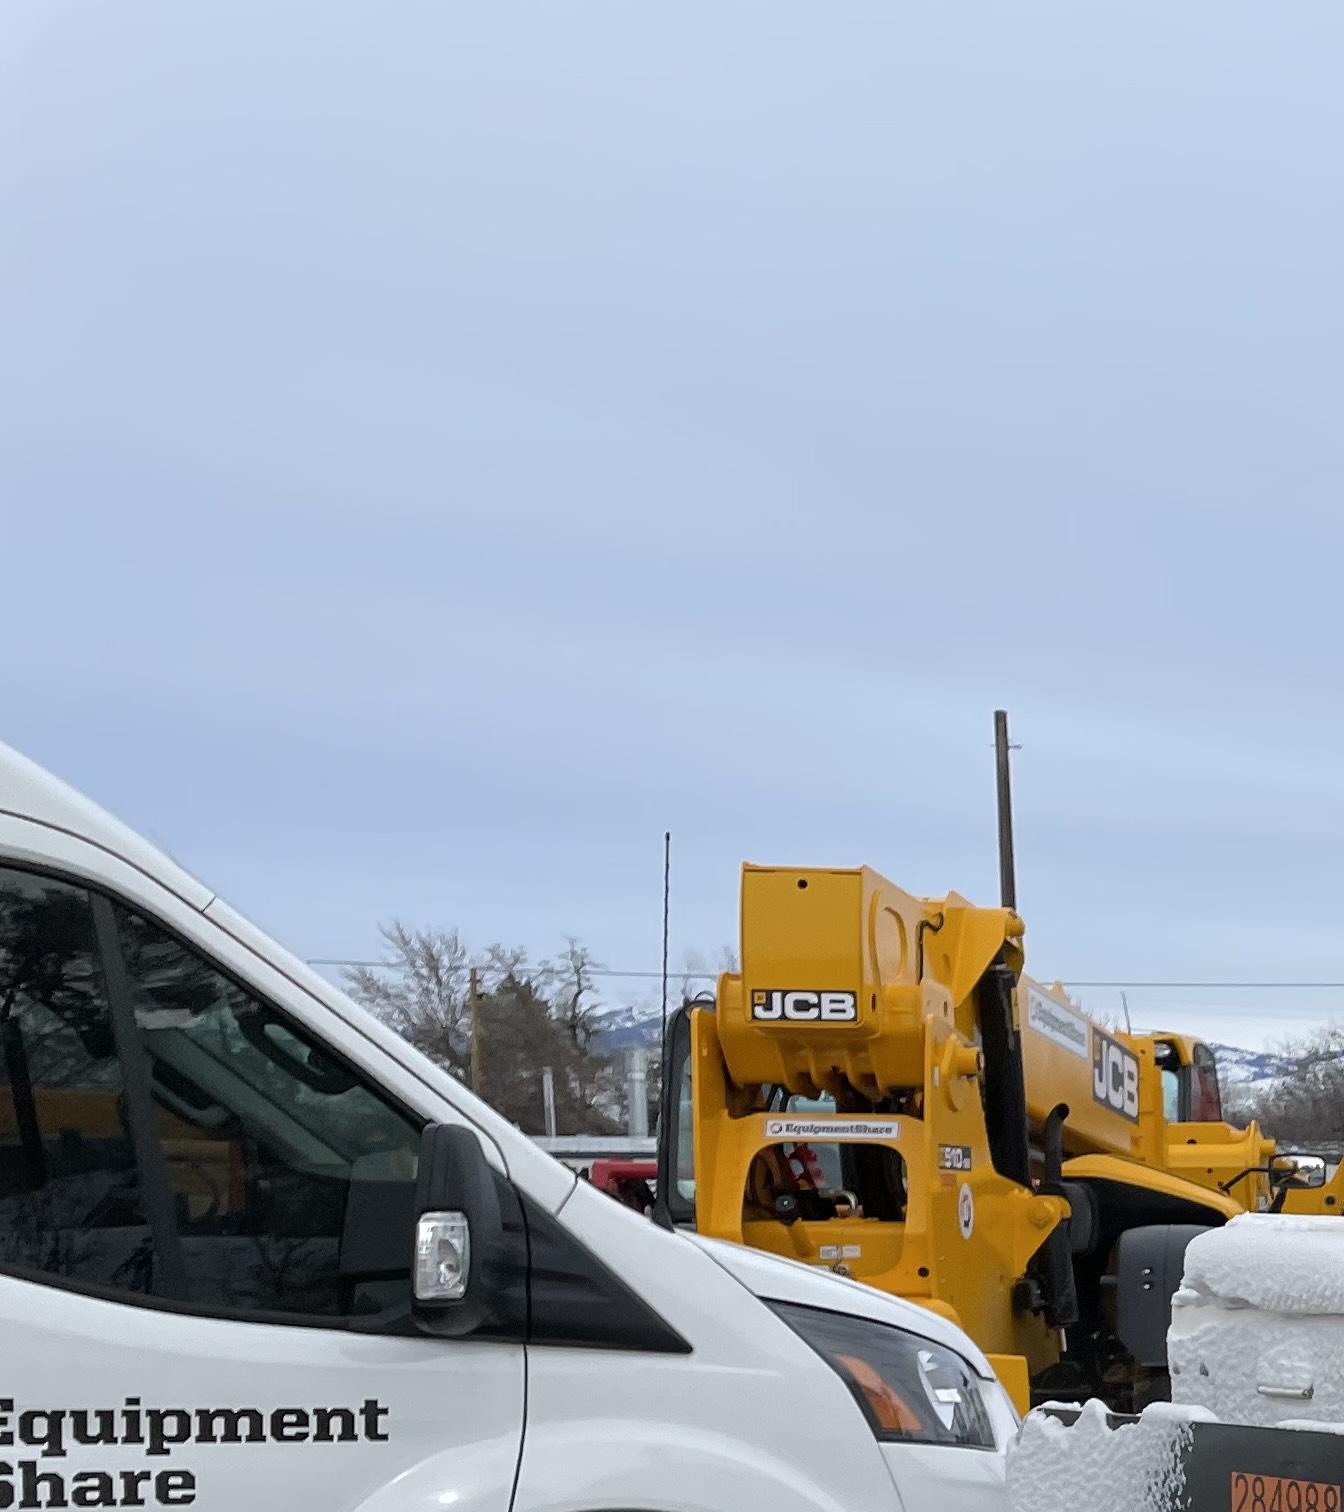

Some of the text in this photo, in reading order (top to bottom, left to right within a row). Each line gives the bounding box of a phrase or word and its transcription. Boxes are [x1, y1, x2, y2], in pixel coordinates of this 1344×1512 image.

[753, 991, 856, 1021] JCB
[1093, 1038, 1140, 1119] JCB
[0, 1397, 389, 1457] quipment
[0, 1460, 196, 1509] hare
